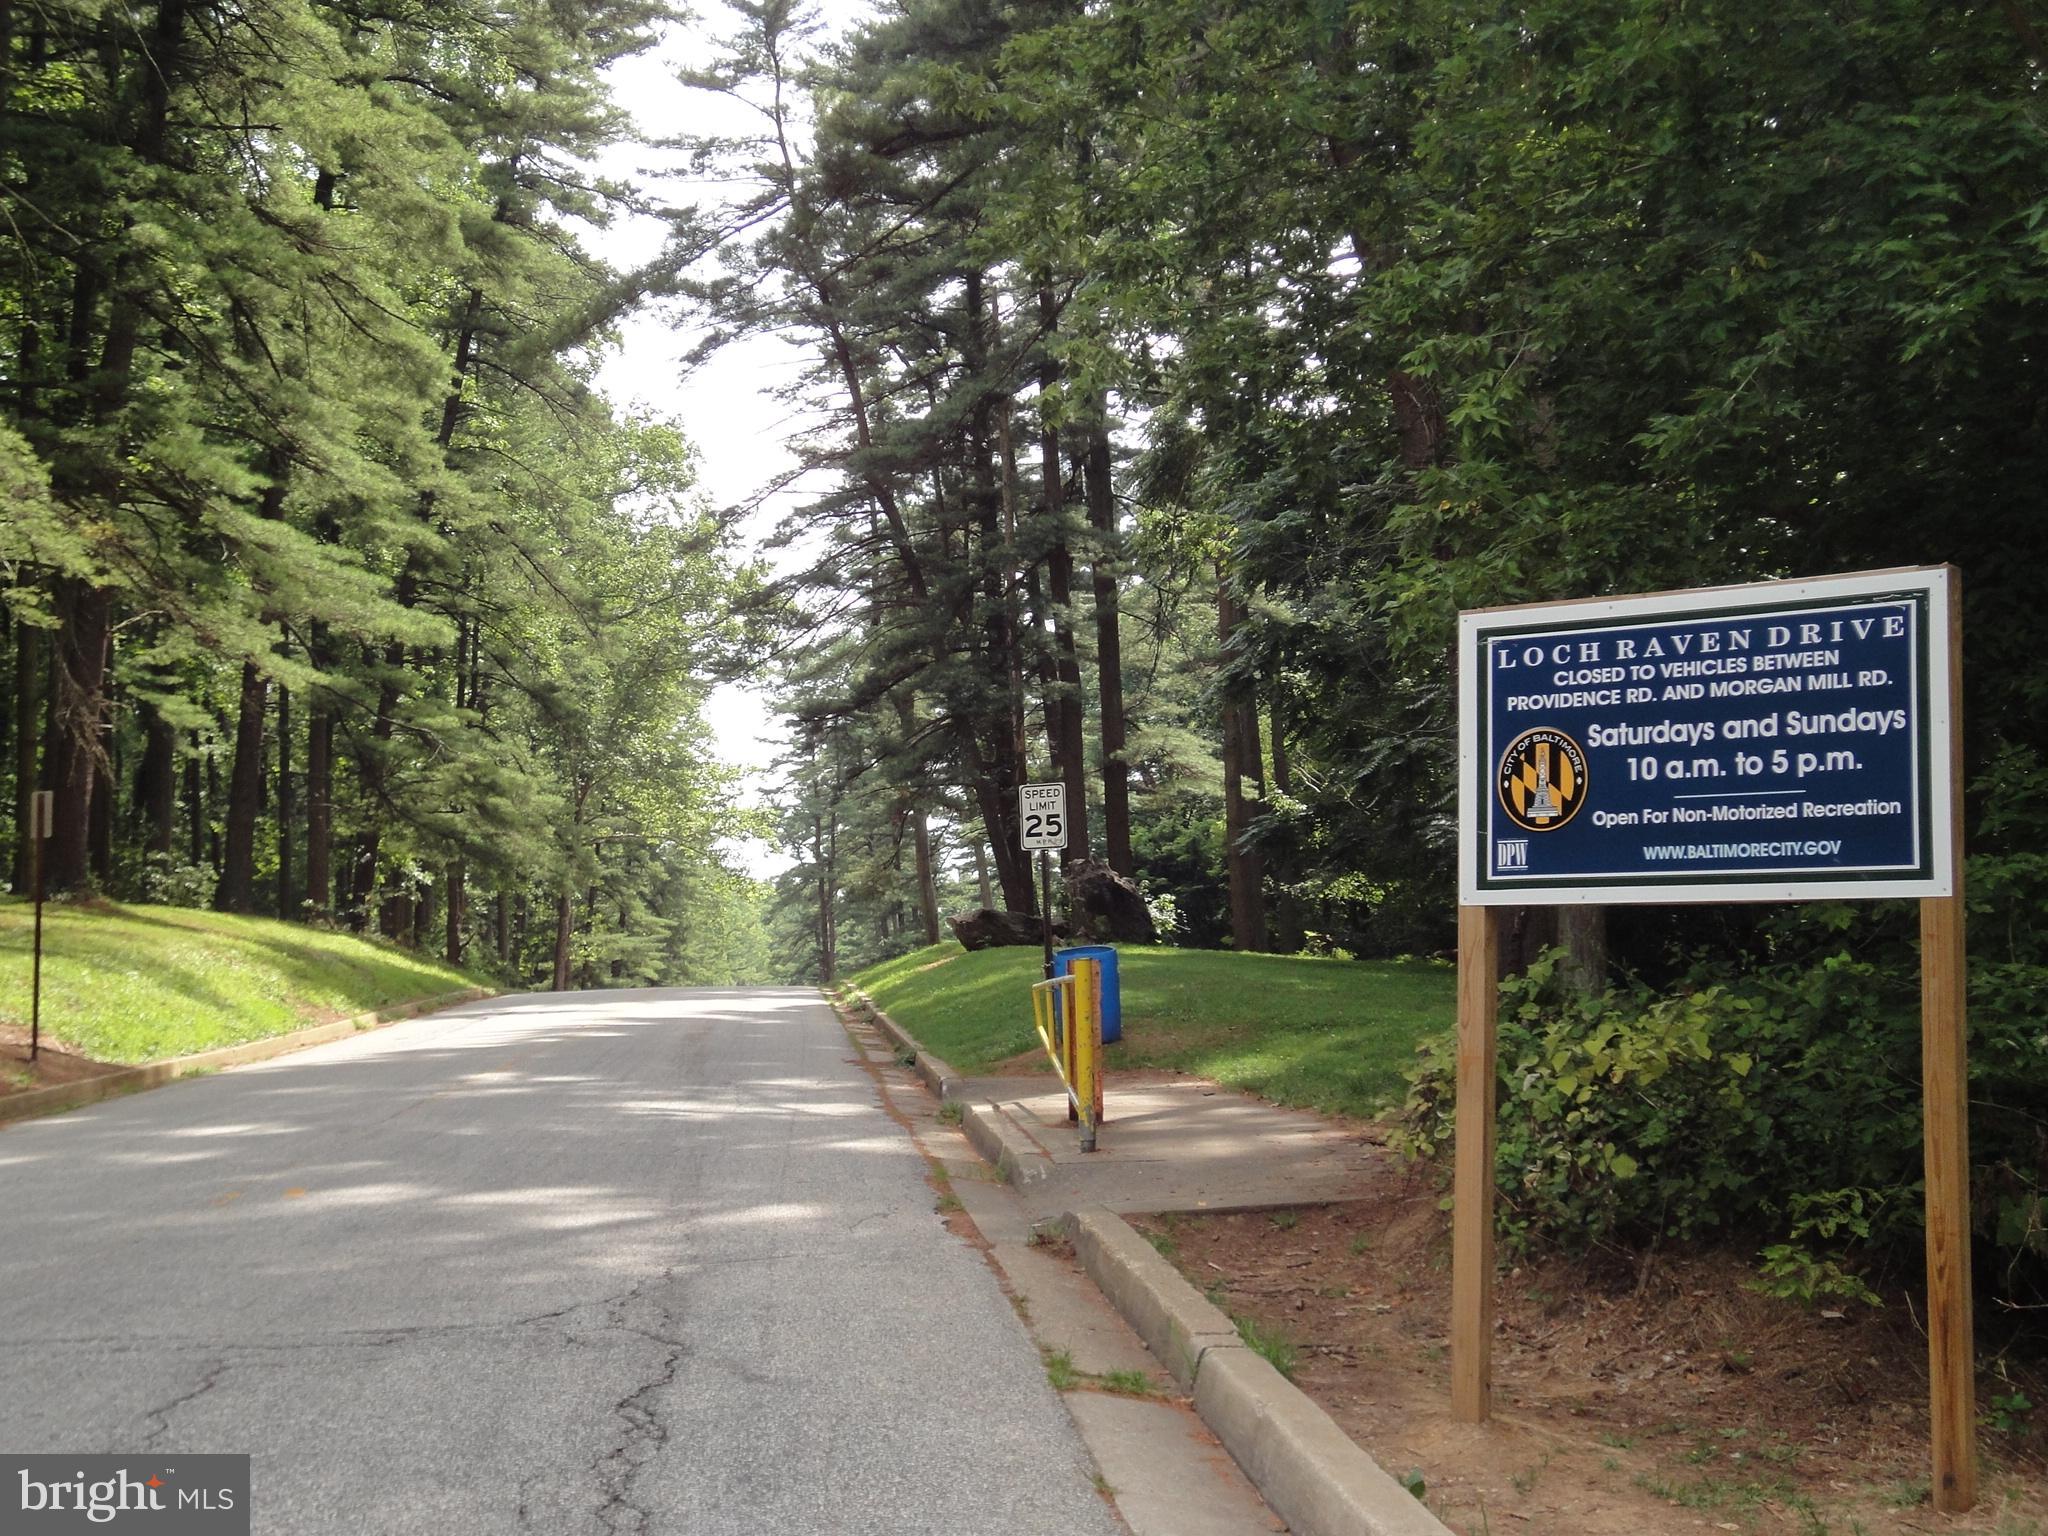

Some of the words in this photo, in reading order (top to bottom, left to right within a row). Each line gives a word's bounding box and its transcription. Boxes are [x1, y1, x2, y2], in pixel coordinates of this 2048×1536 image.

[1498, 640, 1602, 669] LOCH
[1616, 630, 1752, 660] RAVEN
[1768, 616, 1906, 647] DRIVE
[1553, 665, 1625, 687] CLOSED
[1630, 664, 1655, 680] TO
[1661, 657, 1748, 678] VEHICLES
[1753, 649, 1839, 671] BETWEEN
[1508, 690, 1621, 711] PROVIDENCE
[1626, 687, 1658, 703] RD.
[1663, 683, 1705, 700] AND
[1710, 676, 1802, 698] MORGAN
[1808, 671, 1852, 690] MILL
[1859, 670, 1893, 687] RD.
[1587, 718, 1715, 747] Saturdays
[1722, 716, 1777, 739] and
[1786, 708, 1906, 736] Sundays
[1504, 751, 1518, 775] CITY
[1518, 738, 1531, 751] OF
[1533, 734, 1583, 772] BALTIMORE
[1626, 756, 1657, 780] 10
[1665, 756, 1726, 779] a.m.
[1735, 751, 1761, 775] to
[1772, 749, 1788, 773] 5
[1797, 748, 1863, 778] p.m.
[1025, 789, 1060, 799] SPEED
[1030, 801, 1056, 811] LIMIT
[1025, 814, 1062, 837] 25
[1592, 811, 1638, 828] Open
[1643, 808, 1669, 824] For
[1672, 801, 1798, 822] Non-Motorized
[1802, 799, 1901, 817] Recreation
[1498, 843, 1528, 865] DPW
[1643, 840, 1841, 860] WWW.BALTIMORECITY.GOV
